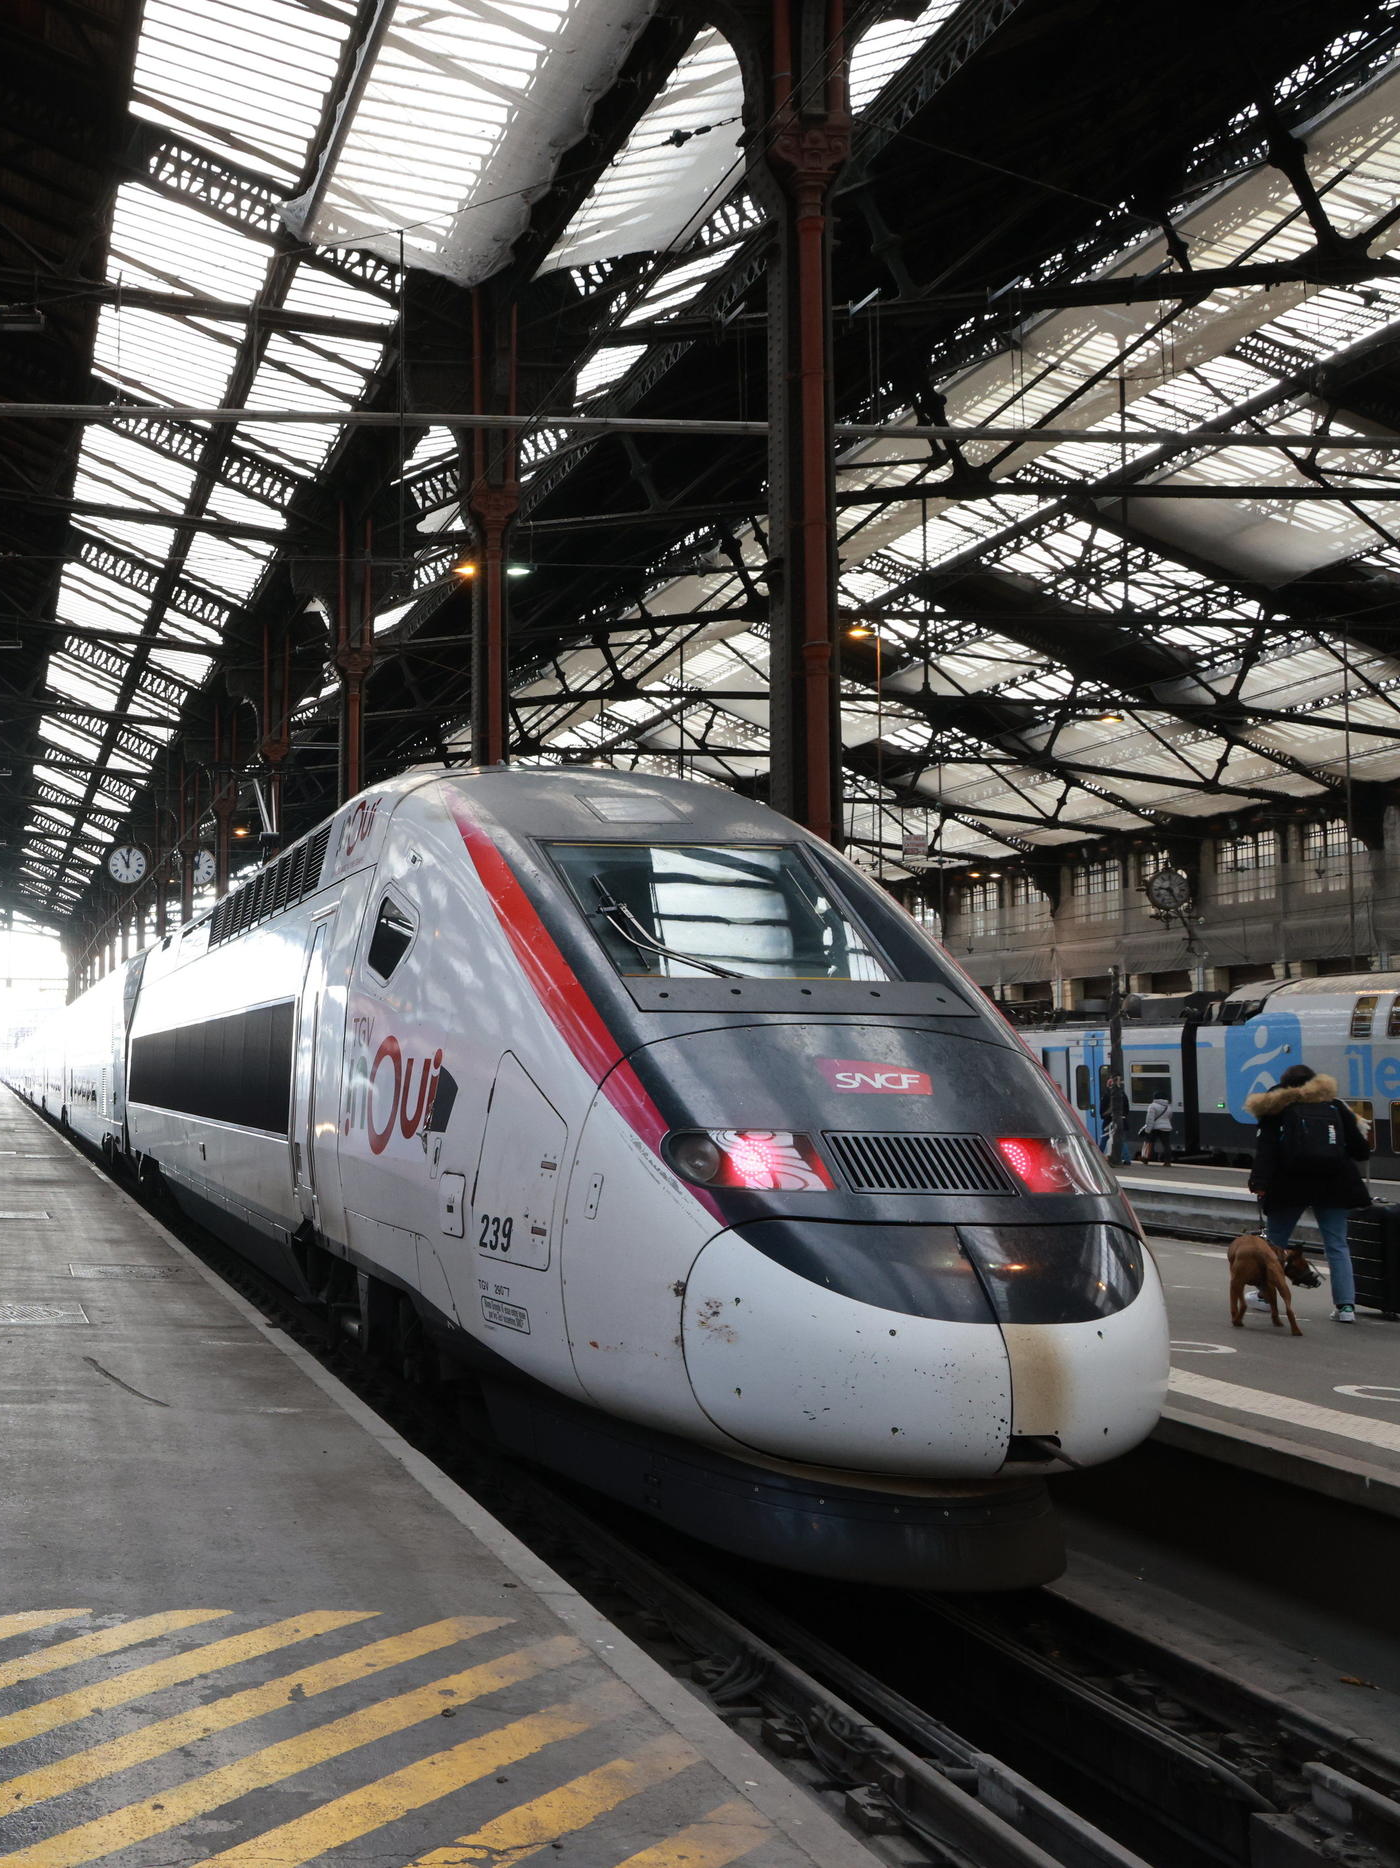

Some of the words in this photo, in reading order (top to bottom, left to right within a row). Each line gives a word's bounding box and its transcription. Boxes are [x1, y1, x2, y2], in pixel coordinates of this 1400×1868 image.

[353, 1016, 375, 1047] TGV
[835, 1072, 920, 1089] SNCF
[479, 1214, 513, 1252] 239
